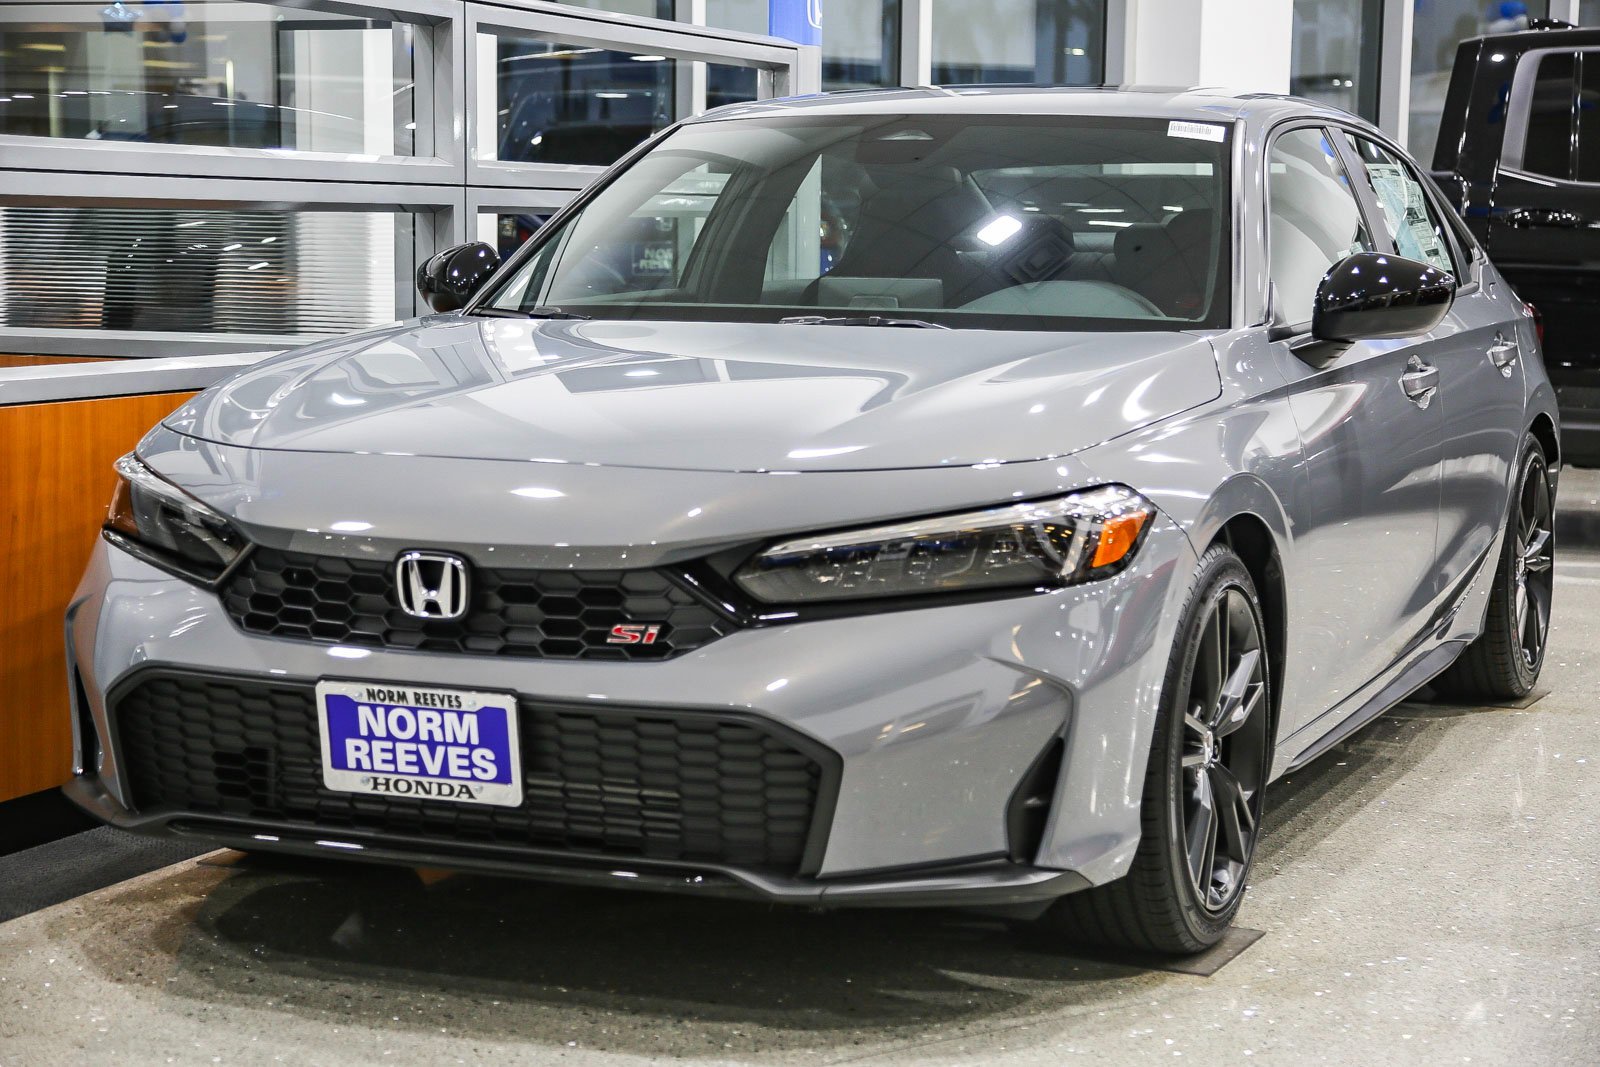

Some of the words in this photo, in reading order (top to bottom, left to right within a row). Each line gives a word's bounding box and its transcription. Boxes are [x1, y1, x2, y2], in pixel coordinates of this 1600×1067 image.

[366, 688, 409, 705] NORM
[414, 691, 462, 709] REEVES
[357, 705, 480, 745] NORM
[345, 738, 498, 781] REEVES
[370, 776, 477, 800] HONDA
